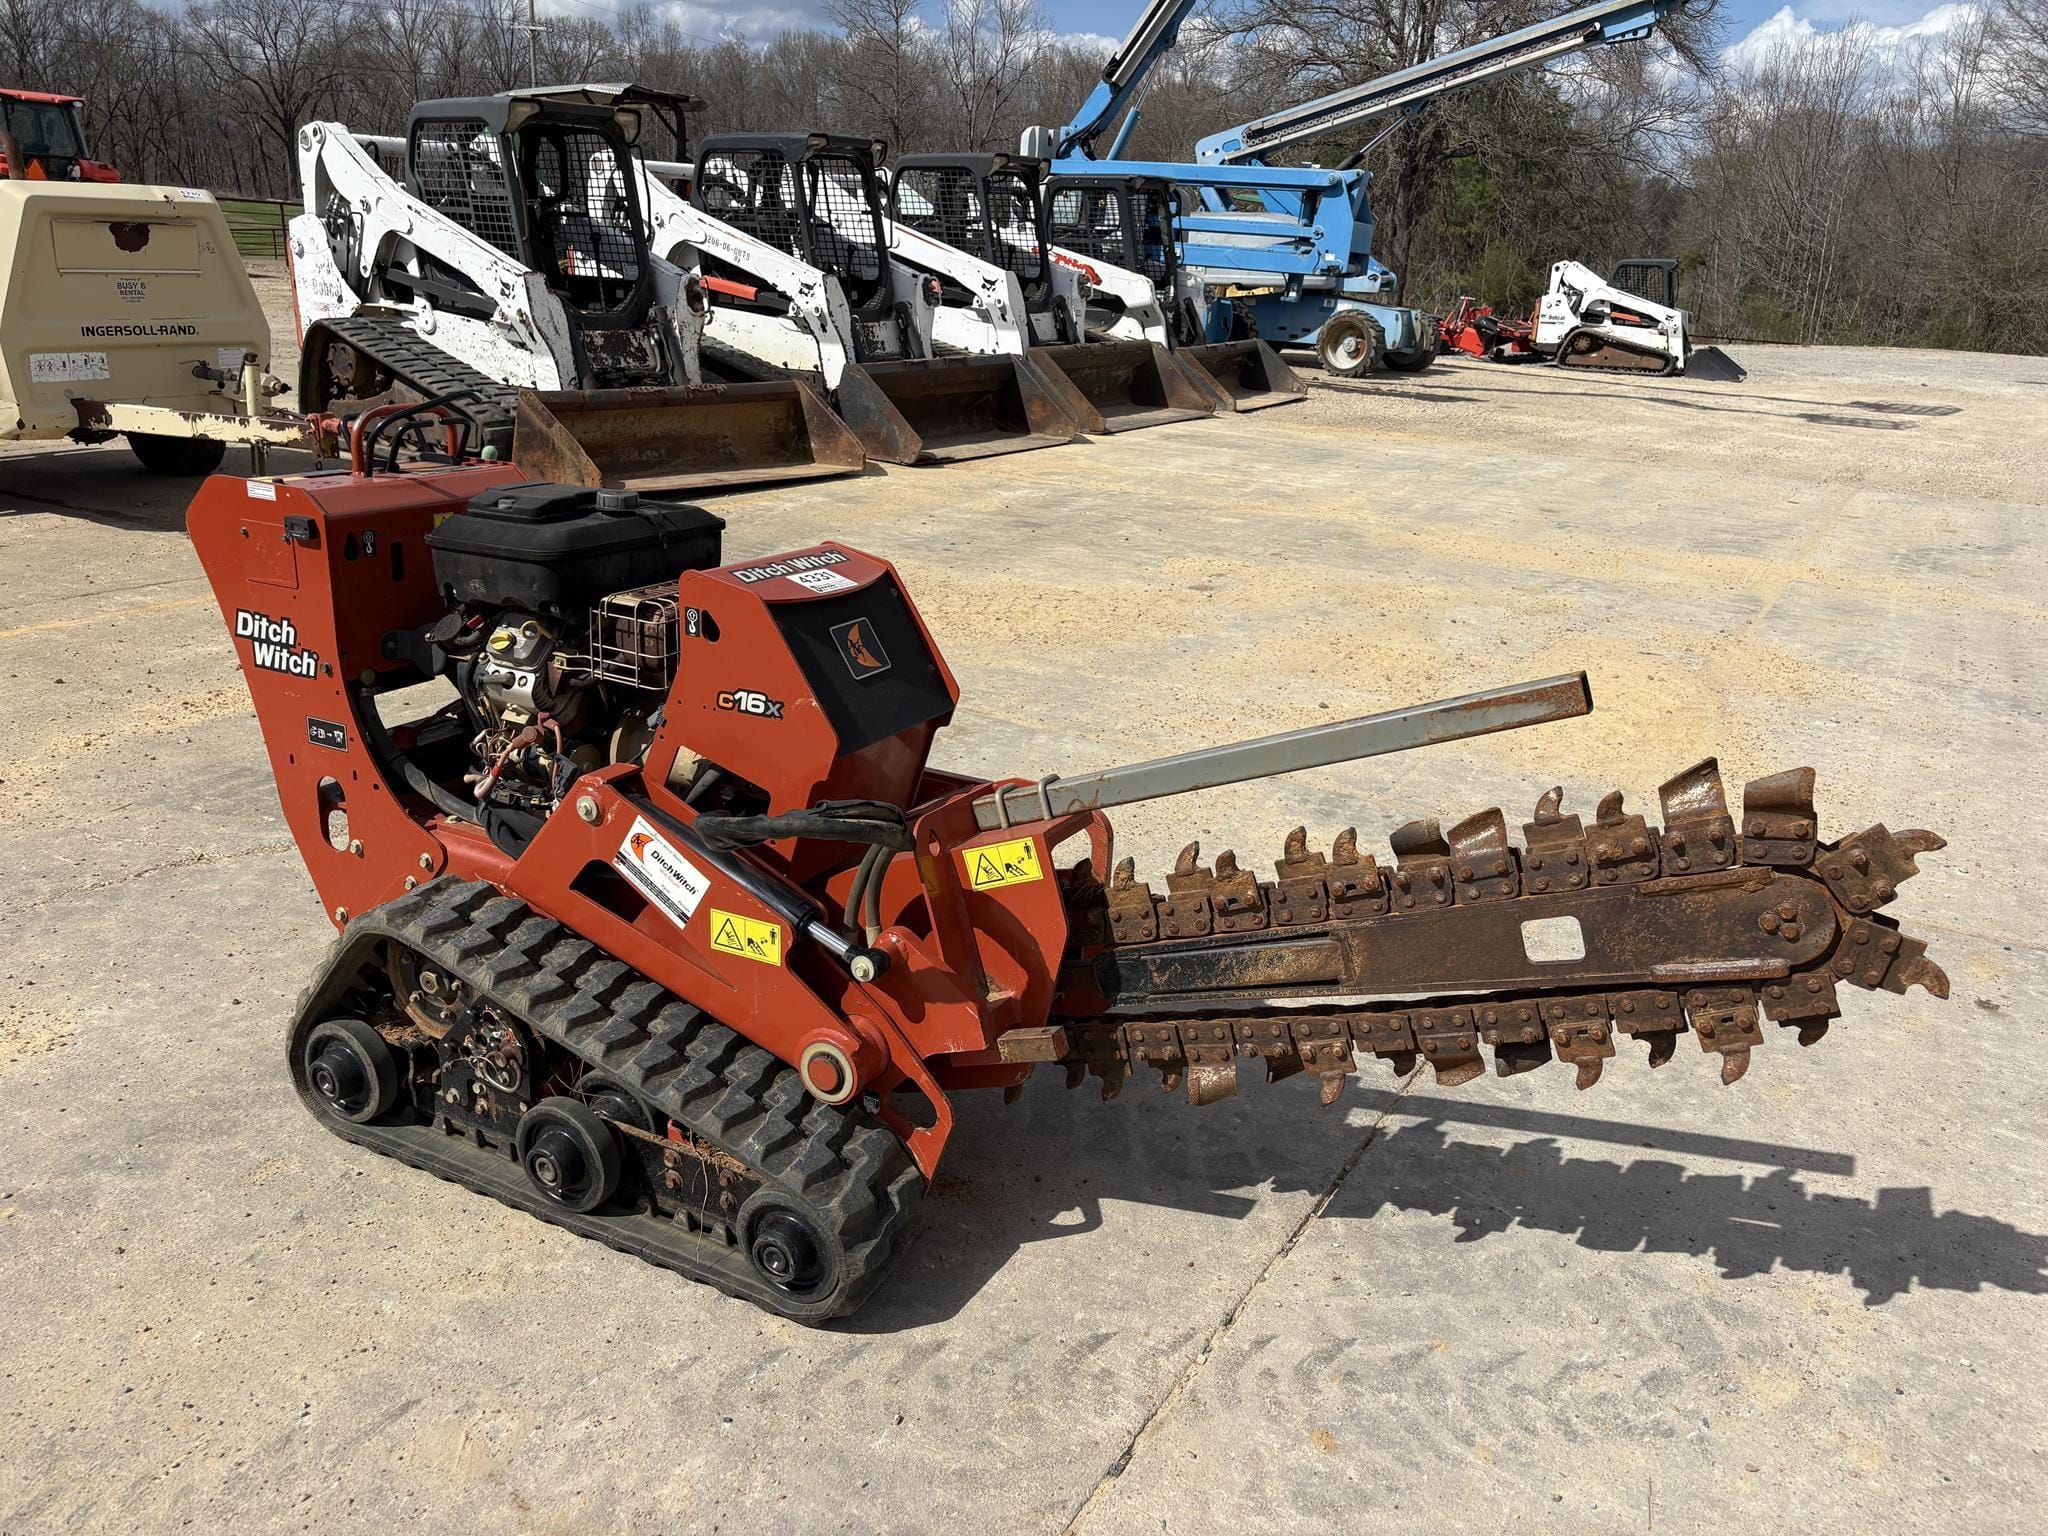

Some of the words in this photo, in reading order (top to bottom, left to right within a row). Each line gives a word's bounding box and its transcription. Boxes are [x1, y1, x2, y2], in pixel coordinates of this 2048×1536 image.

[116, 282, 138, 290] BUSY
[80, 324, 197, 338] INGERSOLL-RAND
[731, 562, 795, 583] Ditch
[785, 551, 848, 570] Witch
[799, 570, 838, 585] 4331
[236, 610, 297, 646] Ditch
[253, 641, 318, 677] Witch
